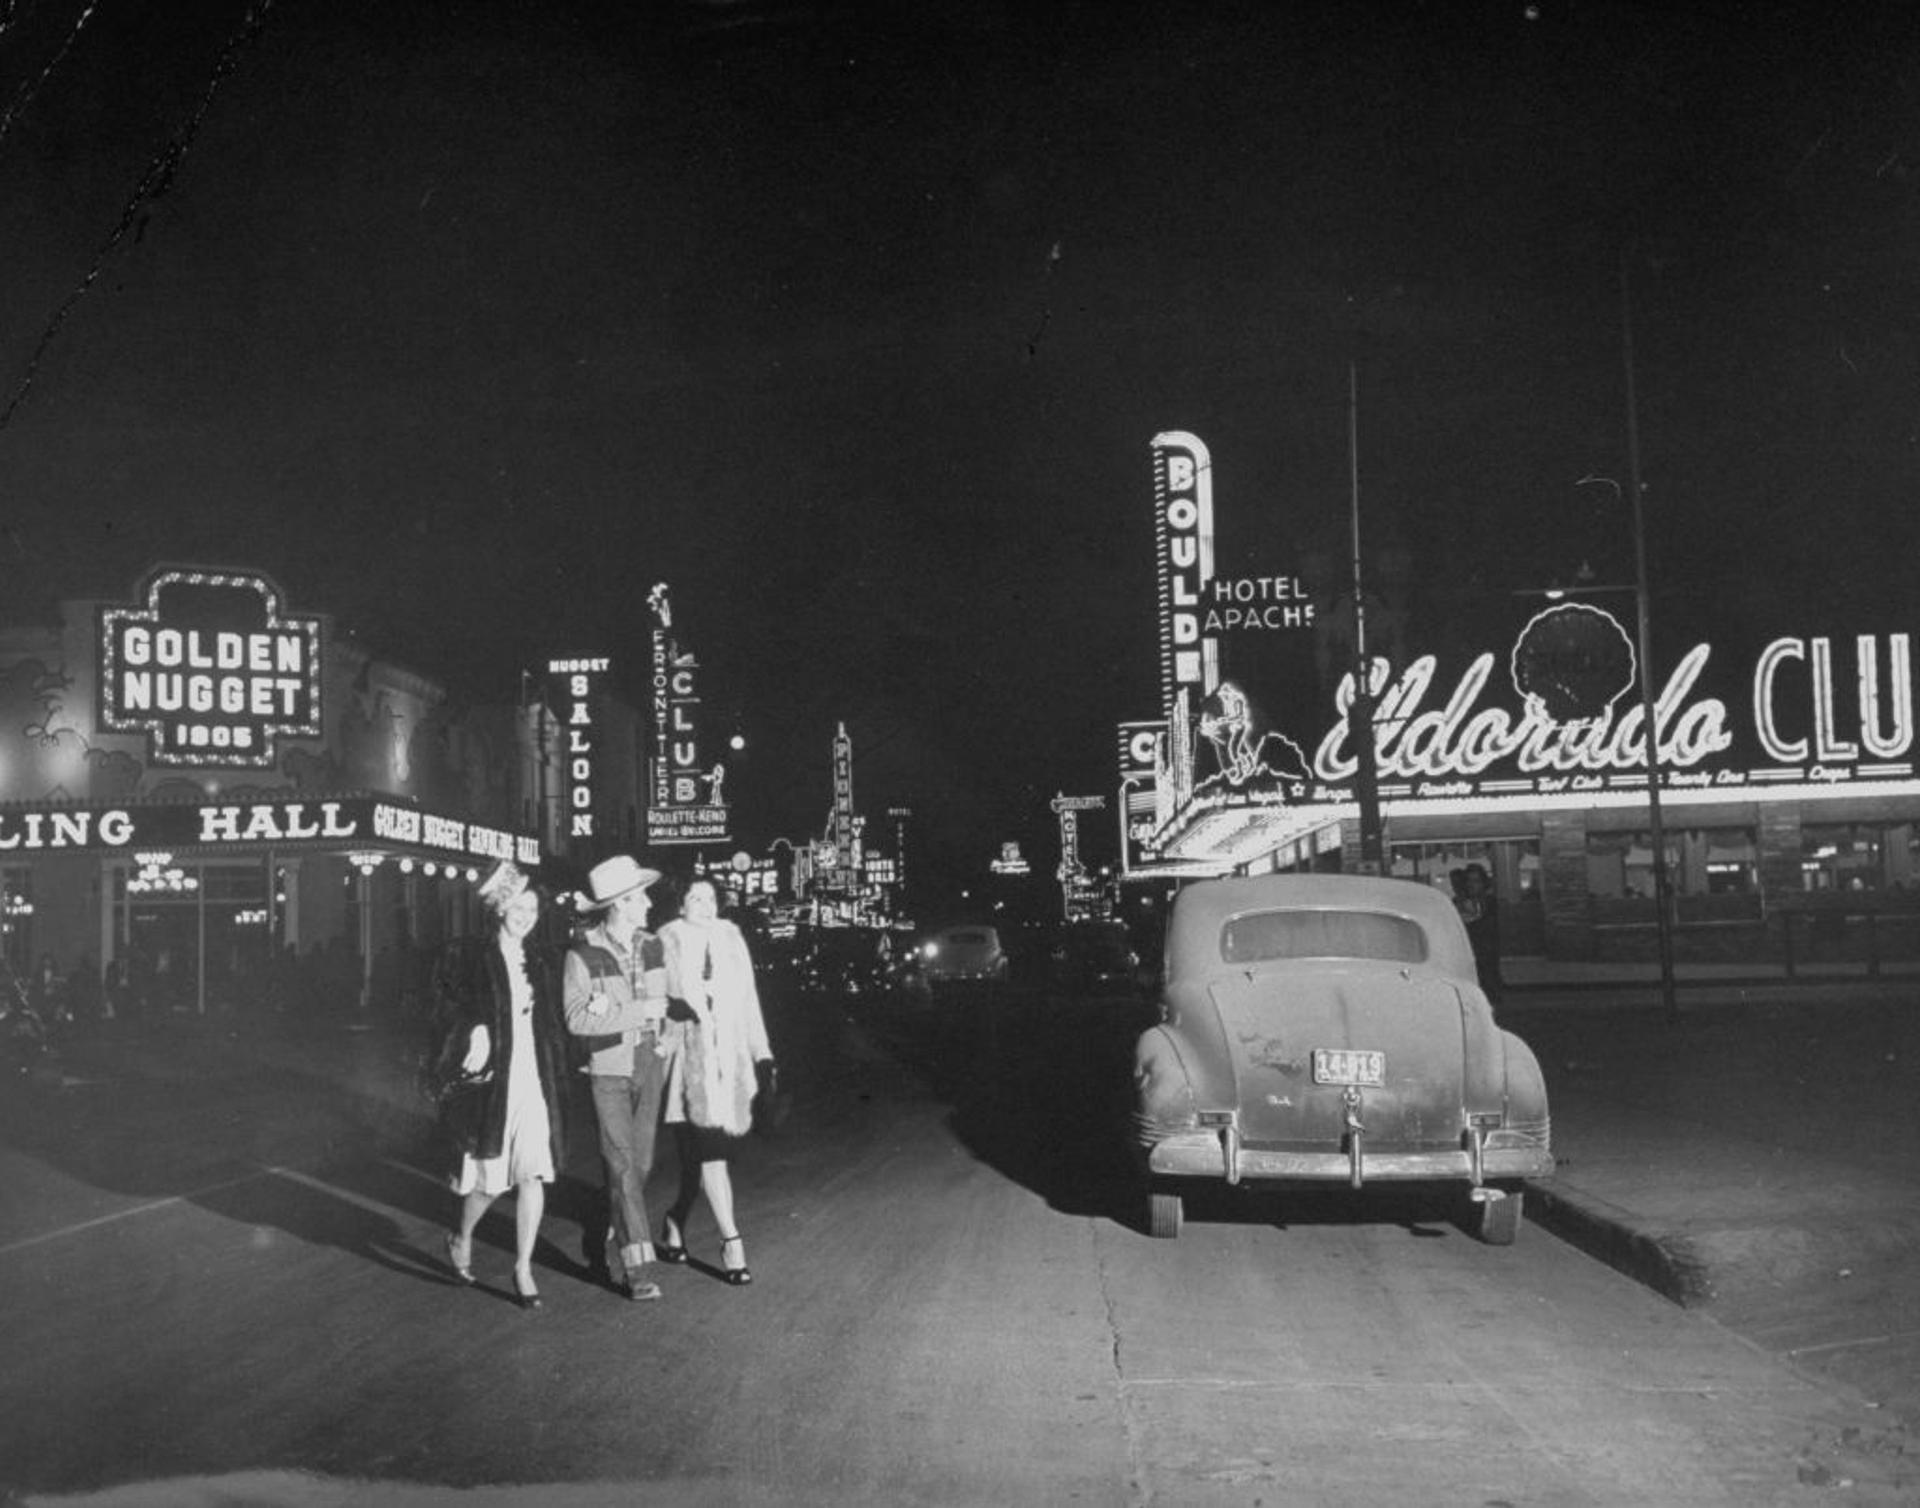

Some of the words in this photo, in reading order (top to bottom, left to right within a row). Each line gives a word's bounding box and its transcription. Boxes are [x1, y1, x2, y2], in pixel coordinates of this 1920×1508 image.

[1167, 455, 1201, 700] BOULDE
[1215, 577, 1308, 601] HOTEL
[125, 627, 300, 676] GOLDEN
[125, 676, 301, 714] NUGGET
[653, 629, 669, 807] FRONTIER
[672, 672, 697, 801] CLUB
[1314, 642, 1732, 781] Eldorado
[1754, 634, 1913, 765] CLU
[570, 675, 592, 836] SALOON
[1716, 768, 1746, 784] One
[200, 803, 356, 841] HALL
